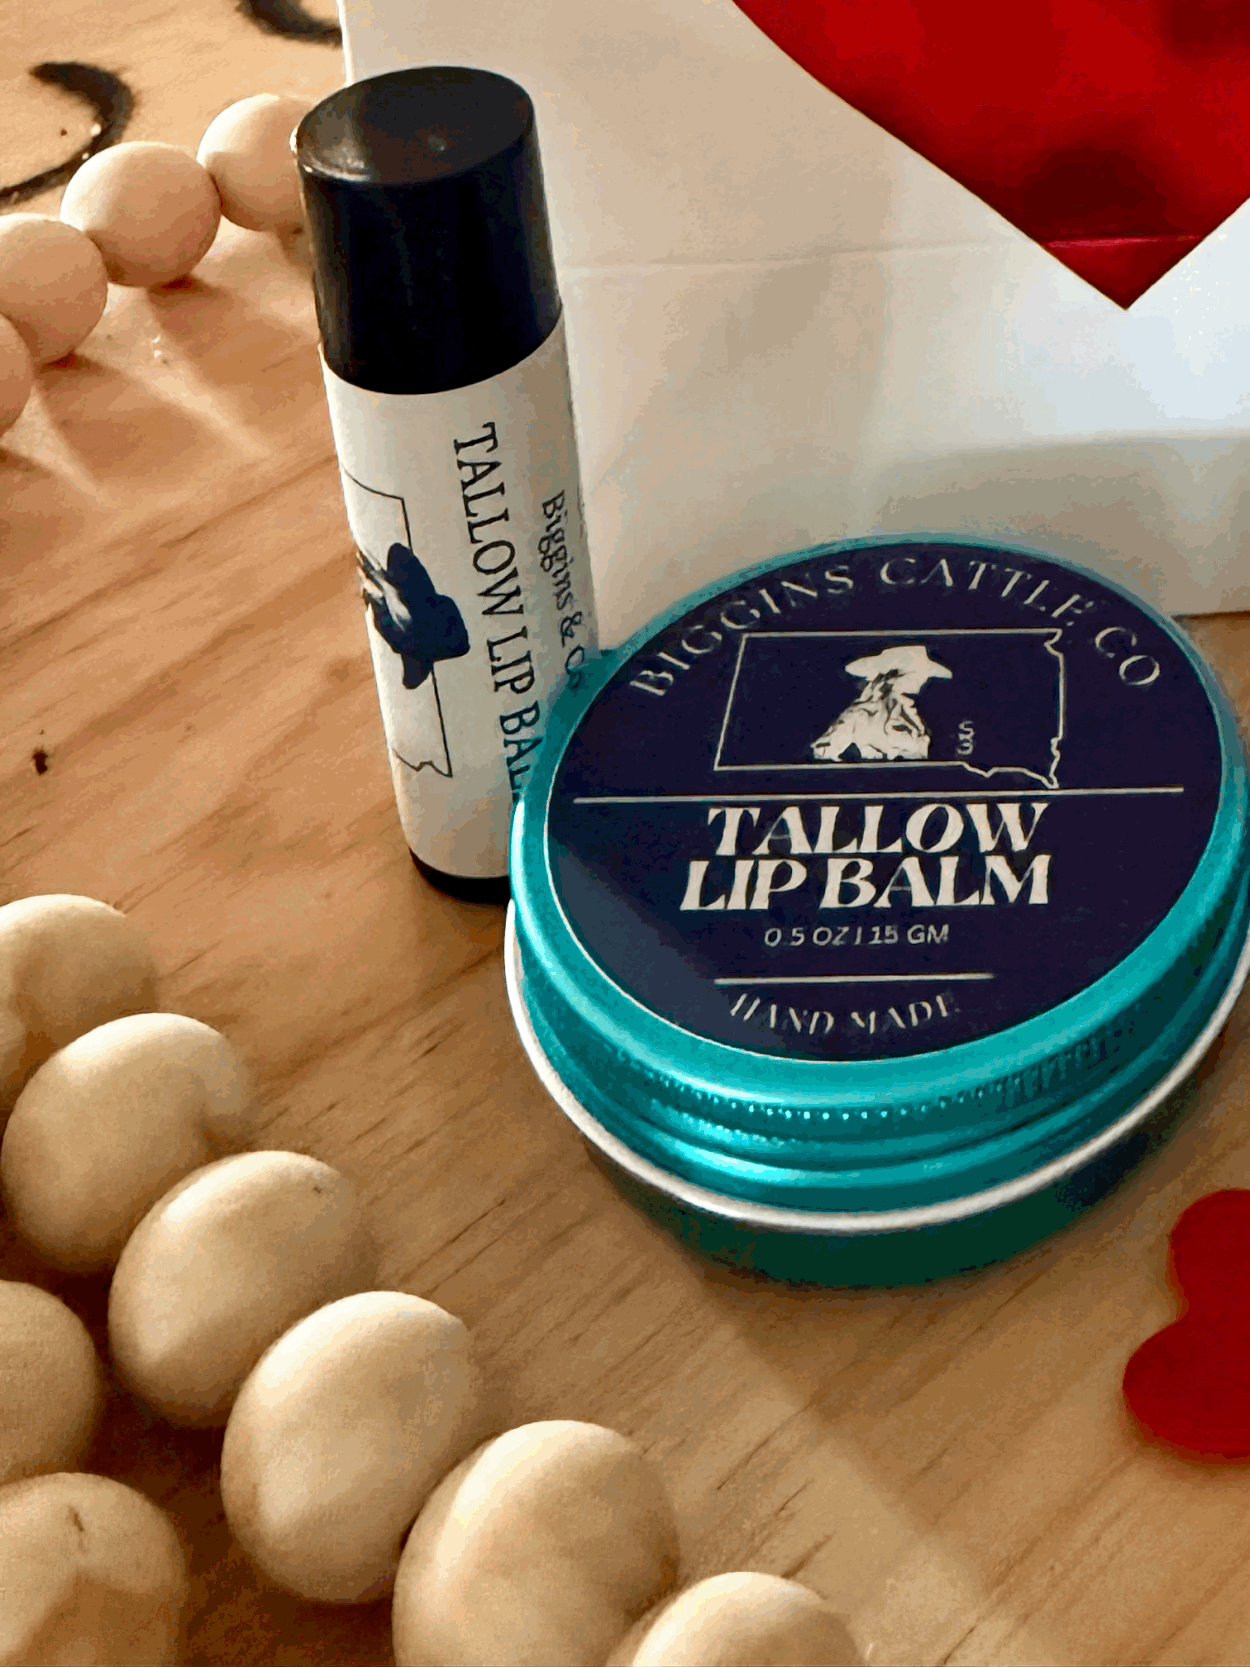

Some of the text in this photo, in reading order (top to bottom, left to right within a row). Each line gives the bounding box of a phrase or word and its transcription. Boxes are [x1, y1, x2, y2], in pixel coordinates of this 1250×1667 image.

[538, 489, 575, 611] Biggins
[560, 611, 583, 648] &
[454, 421, 543, 804] TALLOW LIP BAL
[629, 558, 1160, 696] BIGGINS CATTLE CO
[707, 802, 1050, 856] TALLOW
[679, 854, 1052, 911] LIP BALM
[812, 926, 849, 946] OZ
[868, 925, 899, 944] 15
[907, 923, 949, 944] GM
[729, 990, 962, 1035] HAND MADE
